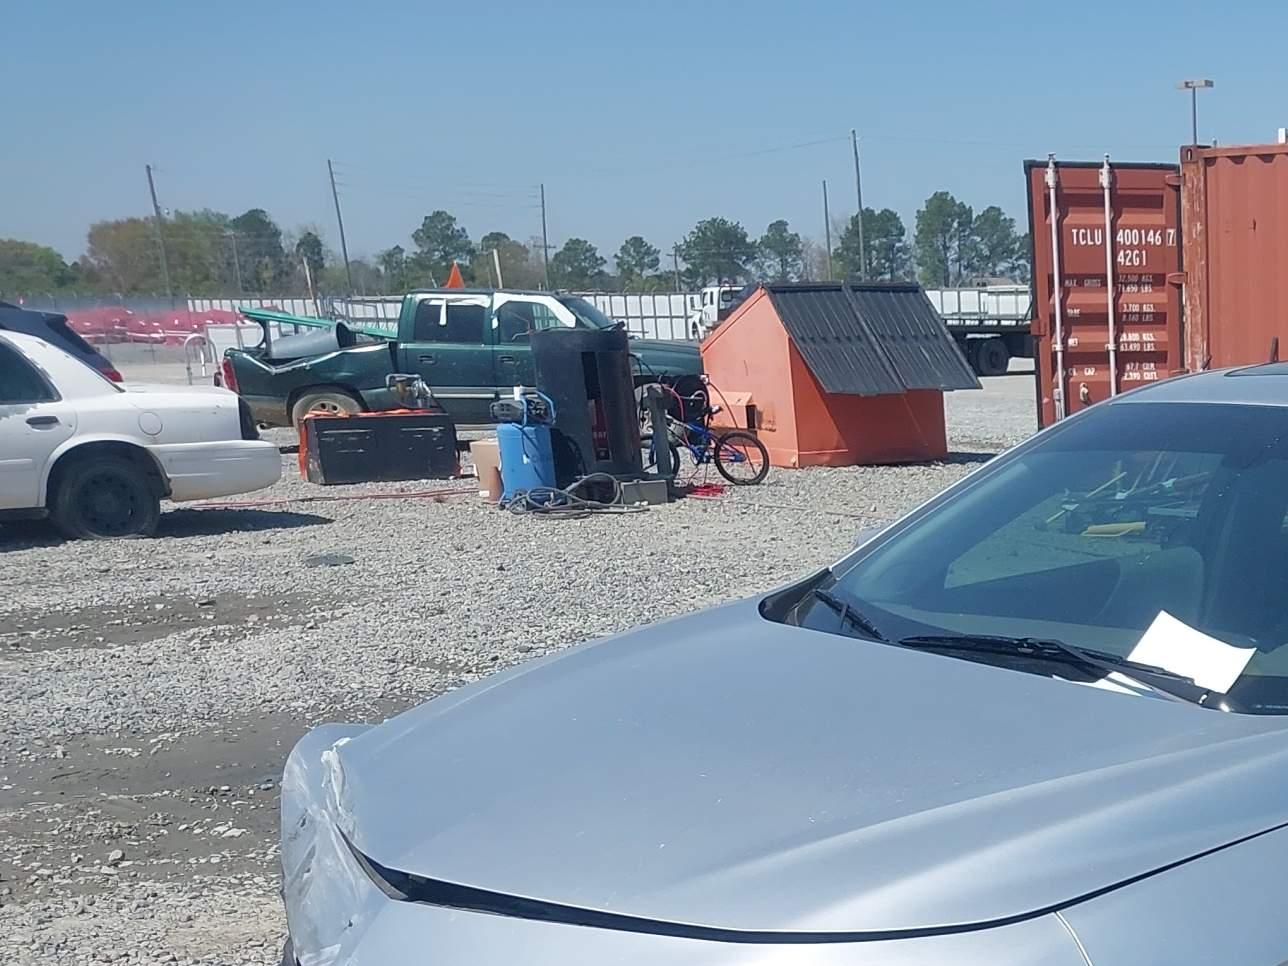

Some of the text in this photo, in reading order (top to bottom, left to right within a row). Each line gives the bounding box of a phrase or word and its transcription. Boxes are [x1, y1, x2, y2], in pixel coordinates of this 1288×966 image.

[1071, 229, 1102, 245] TCLU
[1116, 229, 1162, 246] 400146
[1116, 250, 1147, 266] 42G1
